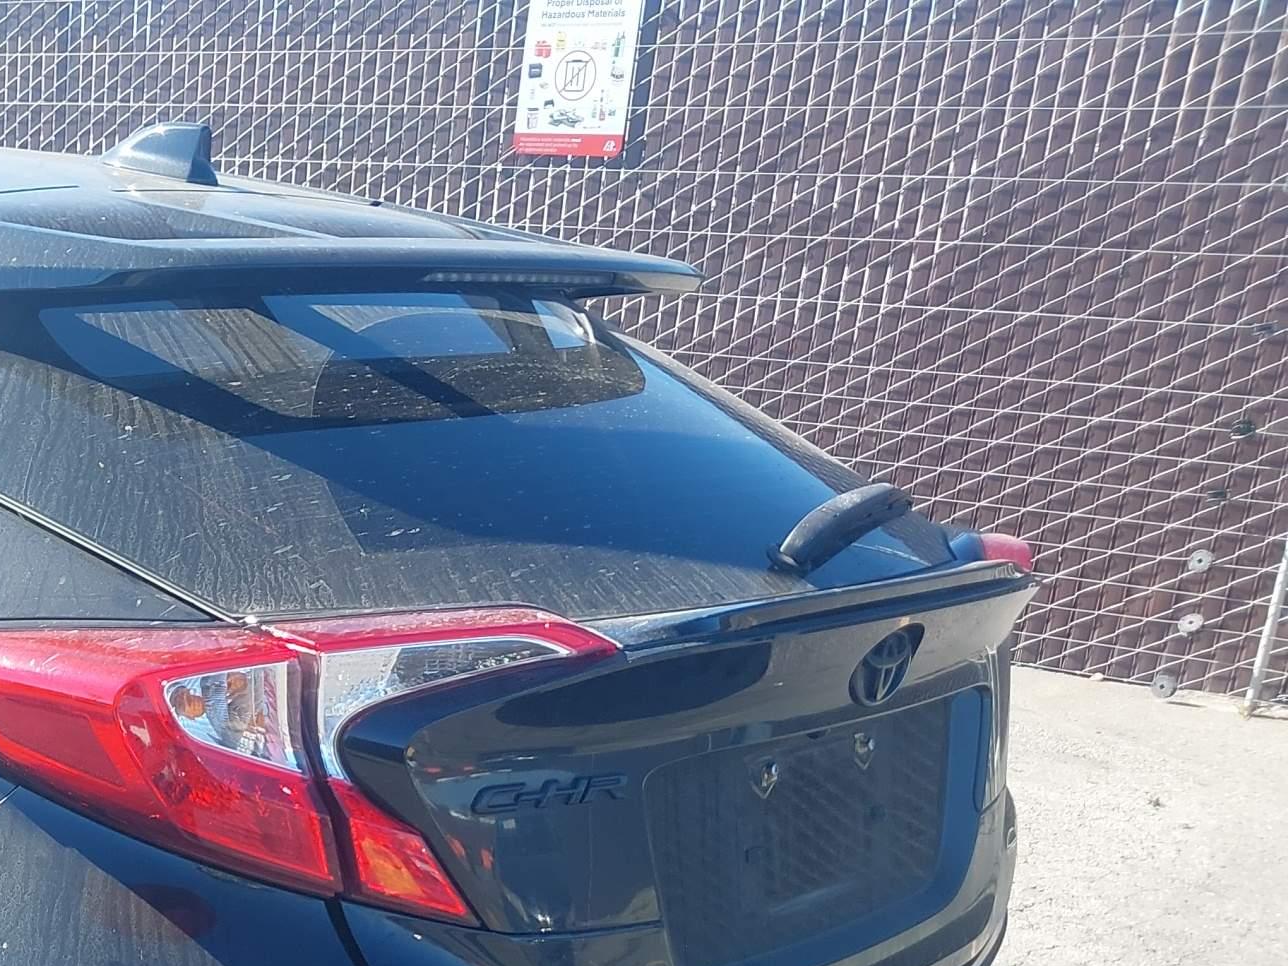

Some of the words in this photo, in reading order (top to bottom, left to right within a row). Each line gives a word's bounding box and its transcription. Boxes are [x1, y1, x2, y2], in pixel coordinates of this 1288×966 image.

[547, 0, 574, 8] Proper
[541, 10, 585, 19] Hazardous
[587, 8, 626, 18] Materials
[470, 773, 628, 815] C-HR
